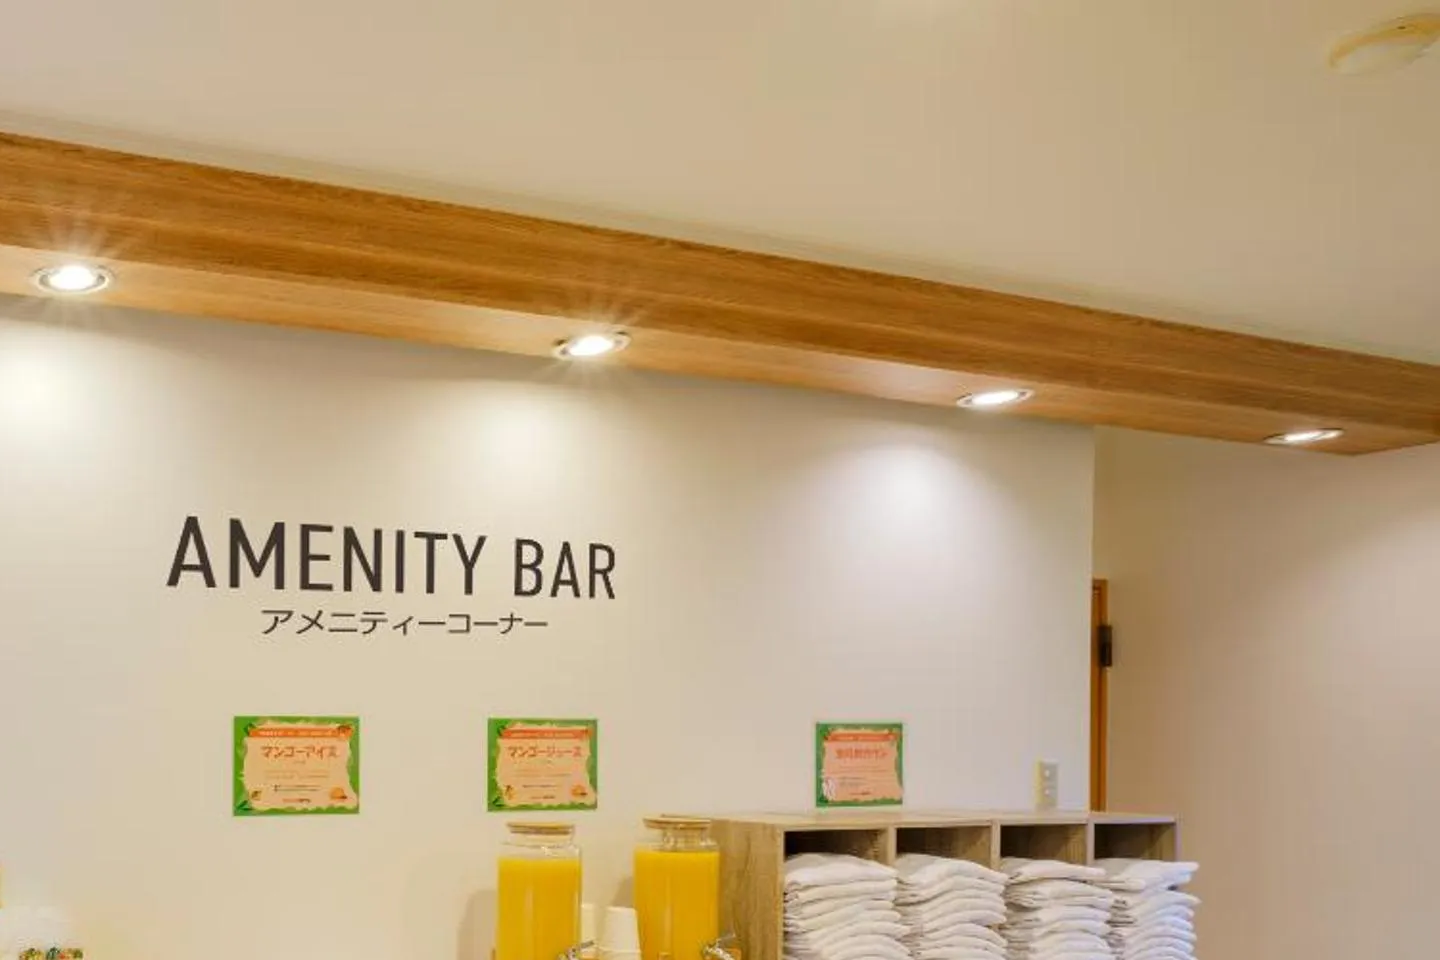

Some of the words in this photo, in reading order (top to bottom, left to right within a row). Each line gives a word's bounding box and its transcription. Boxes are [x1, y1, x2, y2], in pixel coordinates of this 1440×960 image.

[166, 515, 487, 595] AMENITY
[513, 537, 616, 599] BAR
[261, 609, 548, 635] アメニティーコーナー
[260, 744, 339, 760] マンゴーアイス
